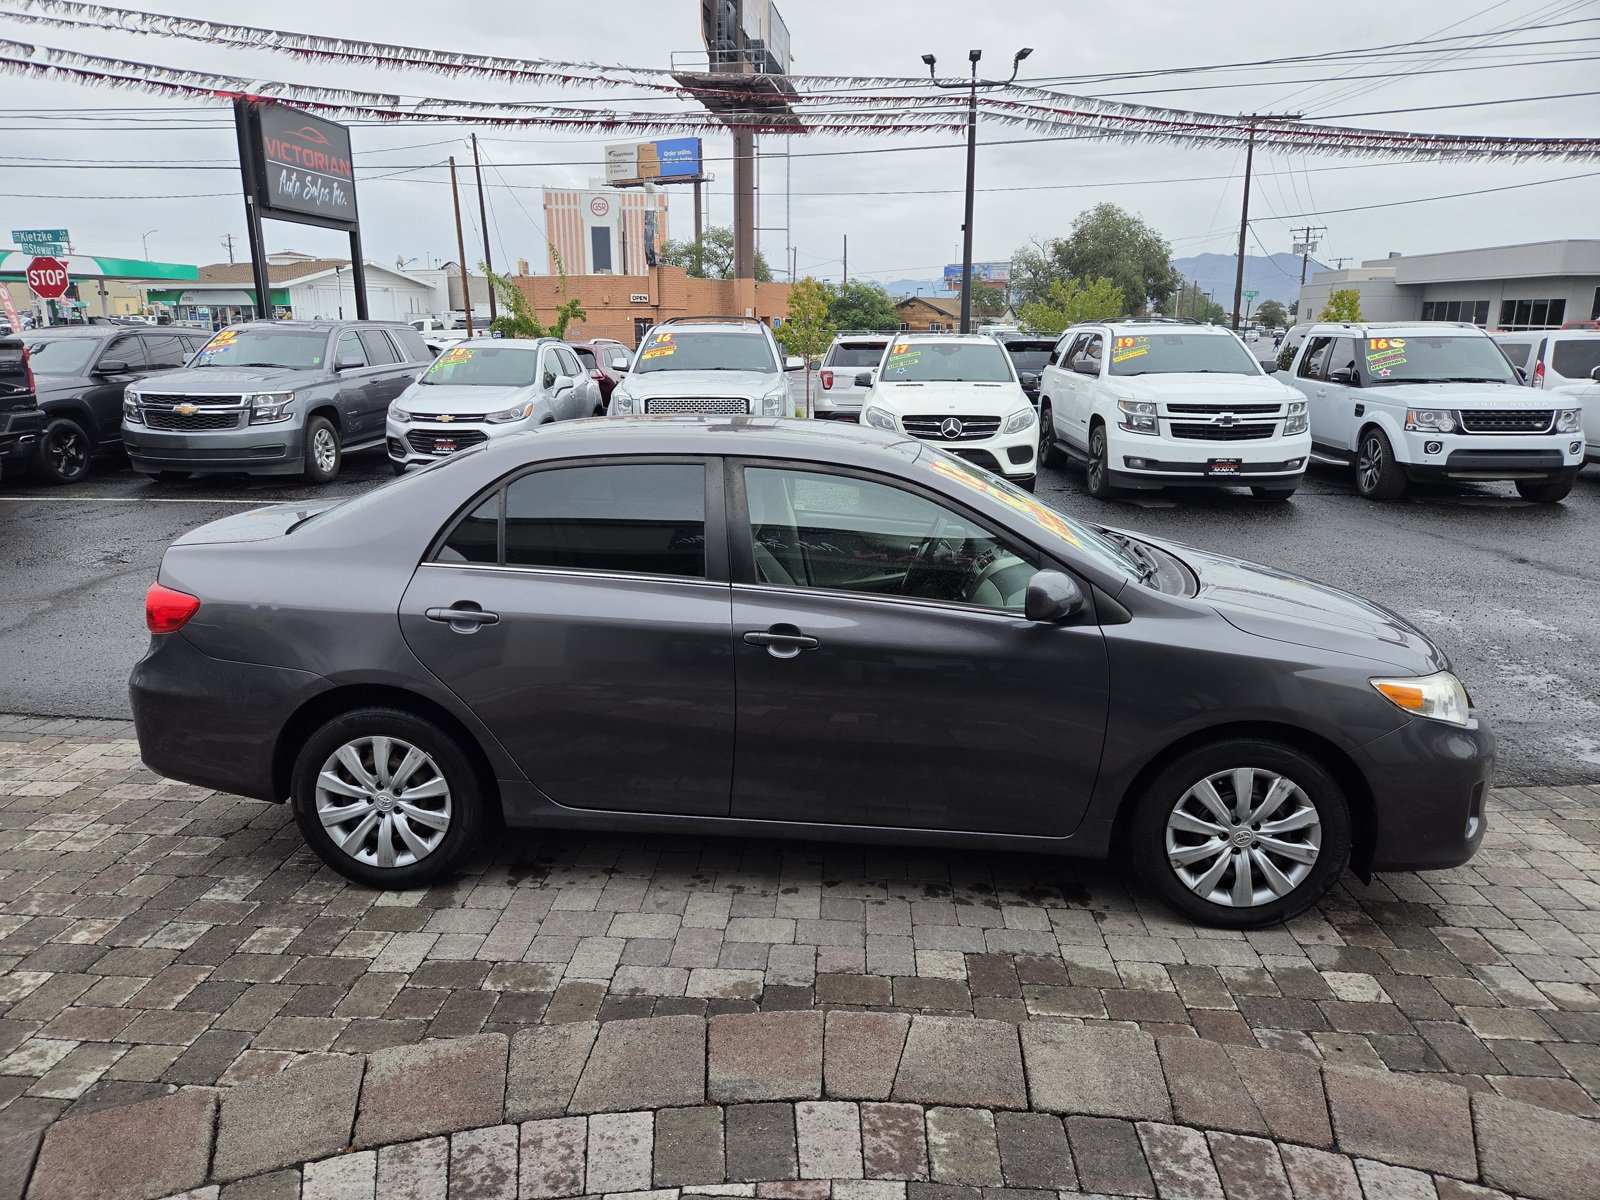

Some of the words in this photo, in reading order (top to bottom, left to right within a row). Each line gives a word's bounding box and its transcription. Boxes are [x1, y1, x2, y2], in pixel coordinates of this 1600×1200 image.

[264, 137, 351, 176] VICTORIAN
[279, 169, 300, 198] Auto
[303, 176, 330, 206] Sales
[593, 202, 607, 211] GSR
[20, 231, 53, 242] Kietzke
[29, 244, 56, 256] Stewart
[30, 270, 65, 286] STOP
[656, 334, 673, 343] 16
[1117, 337, 1134, 348] 19
[1370, 338, 1388, 350] 16
[893, 344, 909, 354] 17
